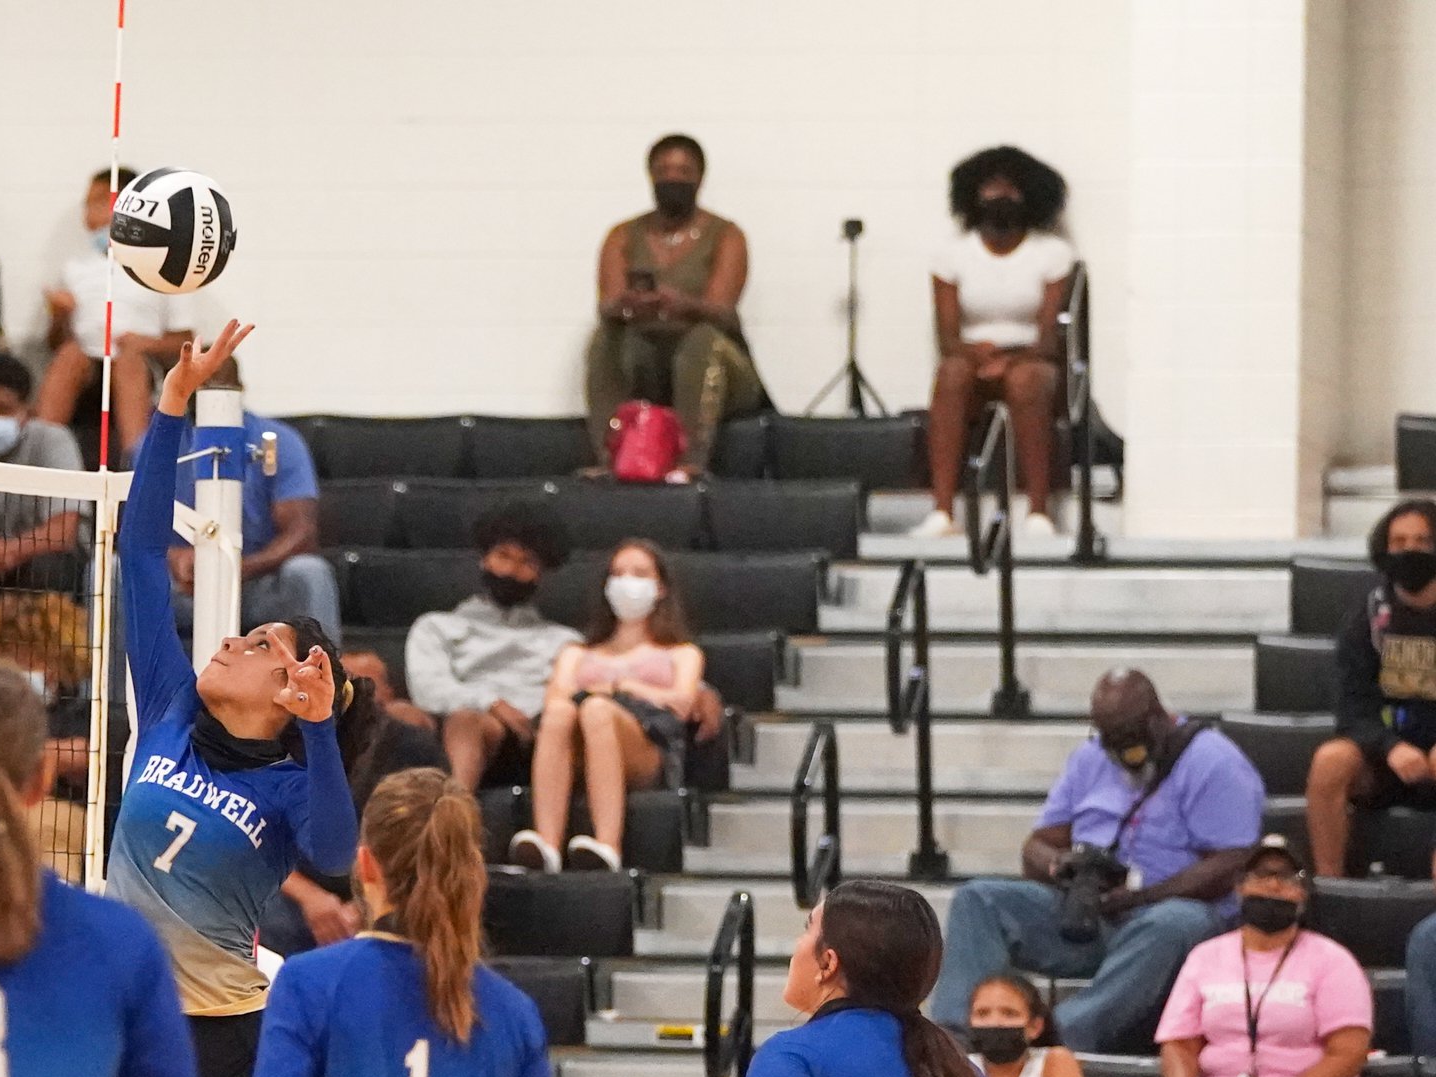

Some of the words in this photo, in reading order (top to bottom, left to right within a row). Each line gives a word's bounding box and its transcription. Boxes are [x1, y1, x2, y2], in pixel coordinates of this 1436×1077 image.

[193, 205, 216, 275] molten
[136, 754, 270, 850] BRADWELL
[153, 810, 198, 874] 7
